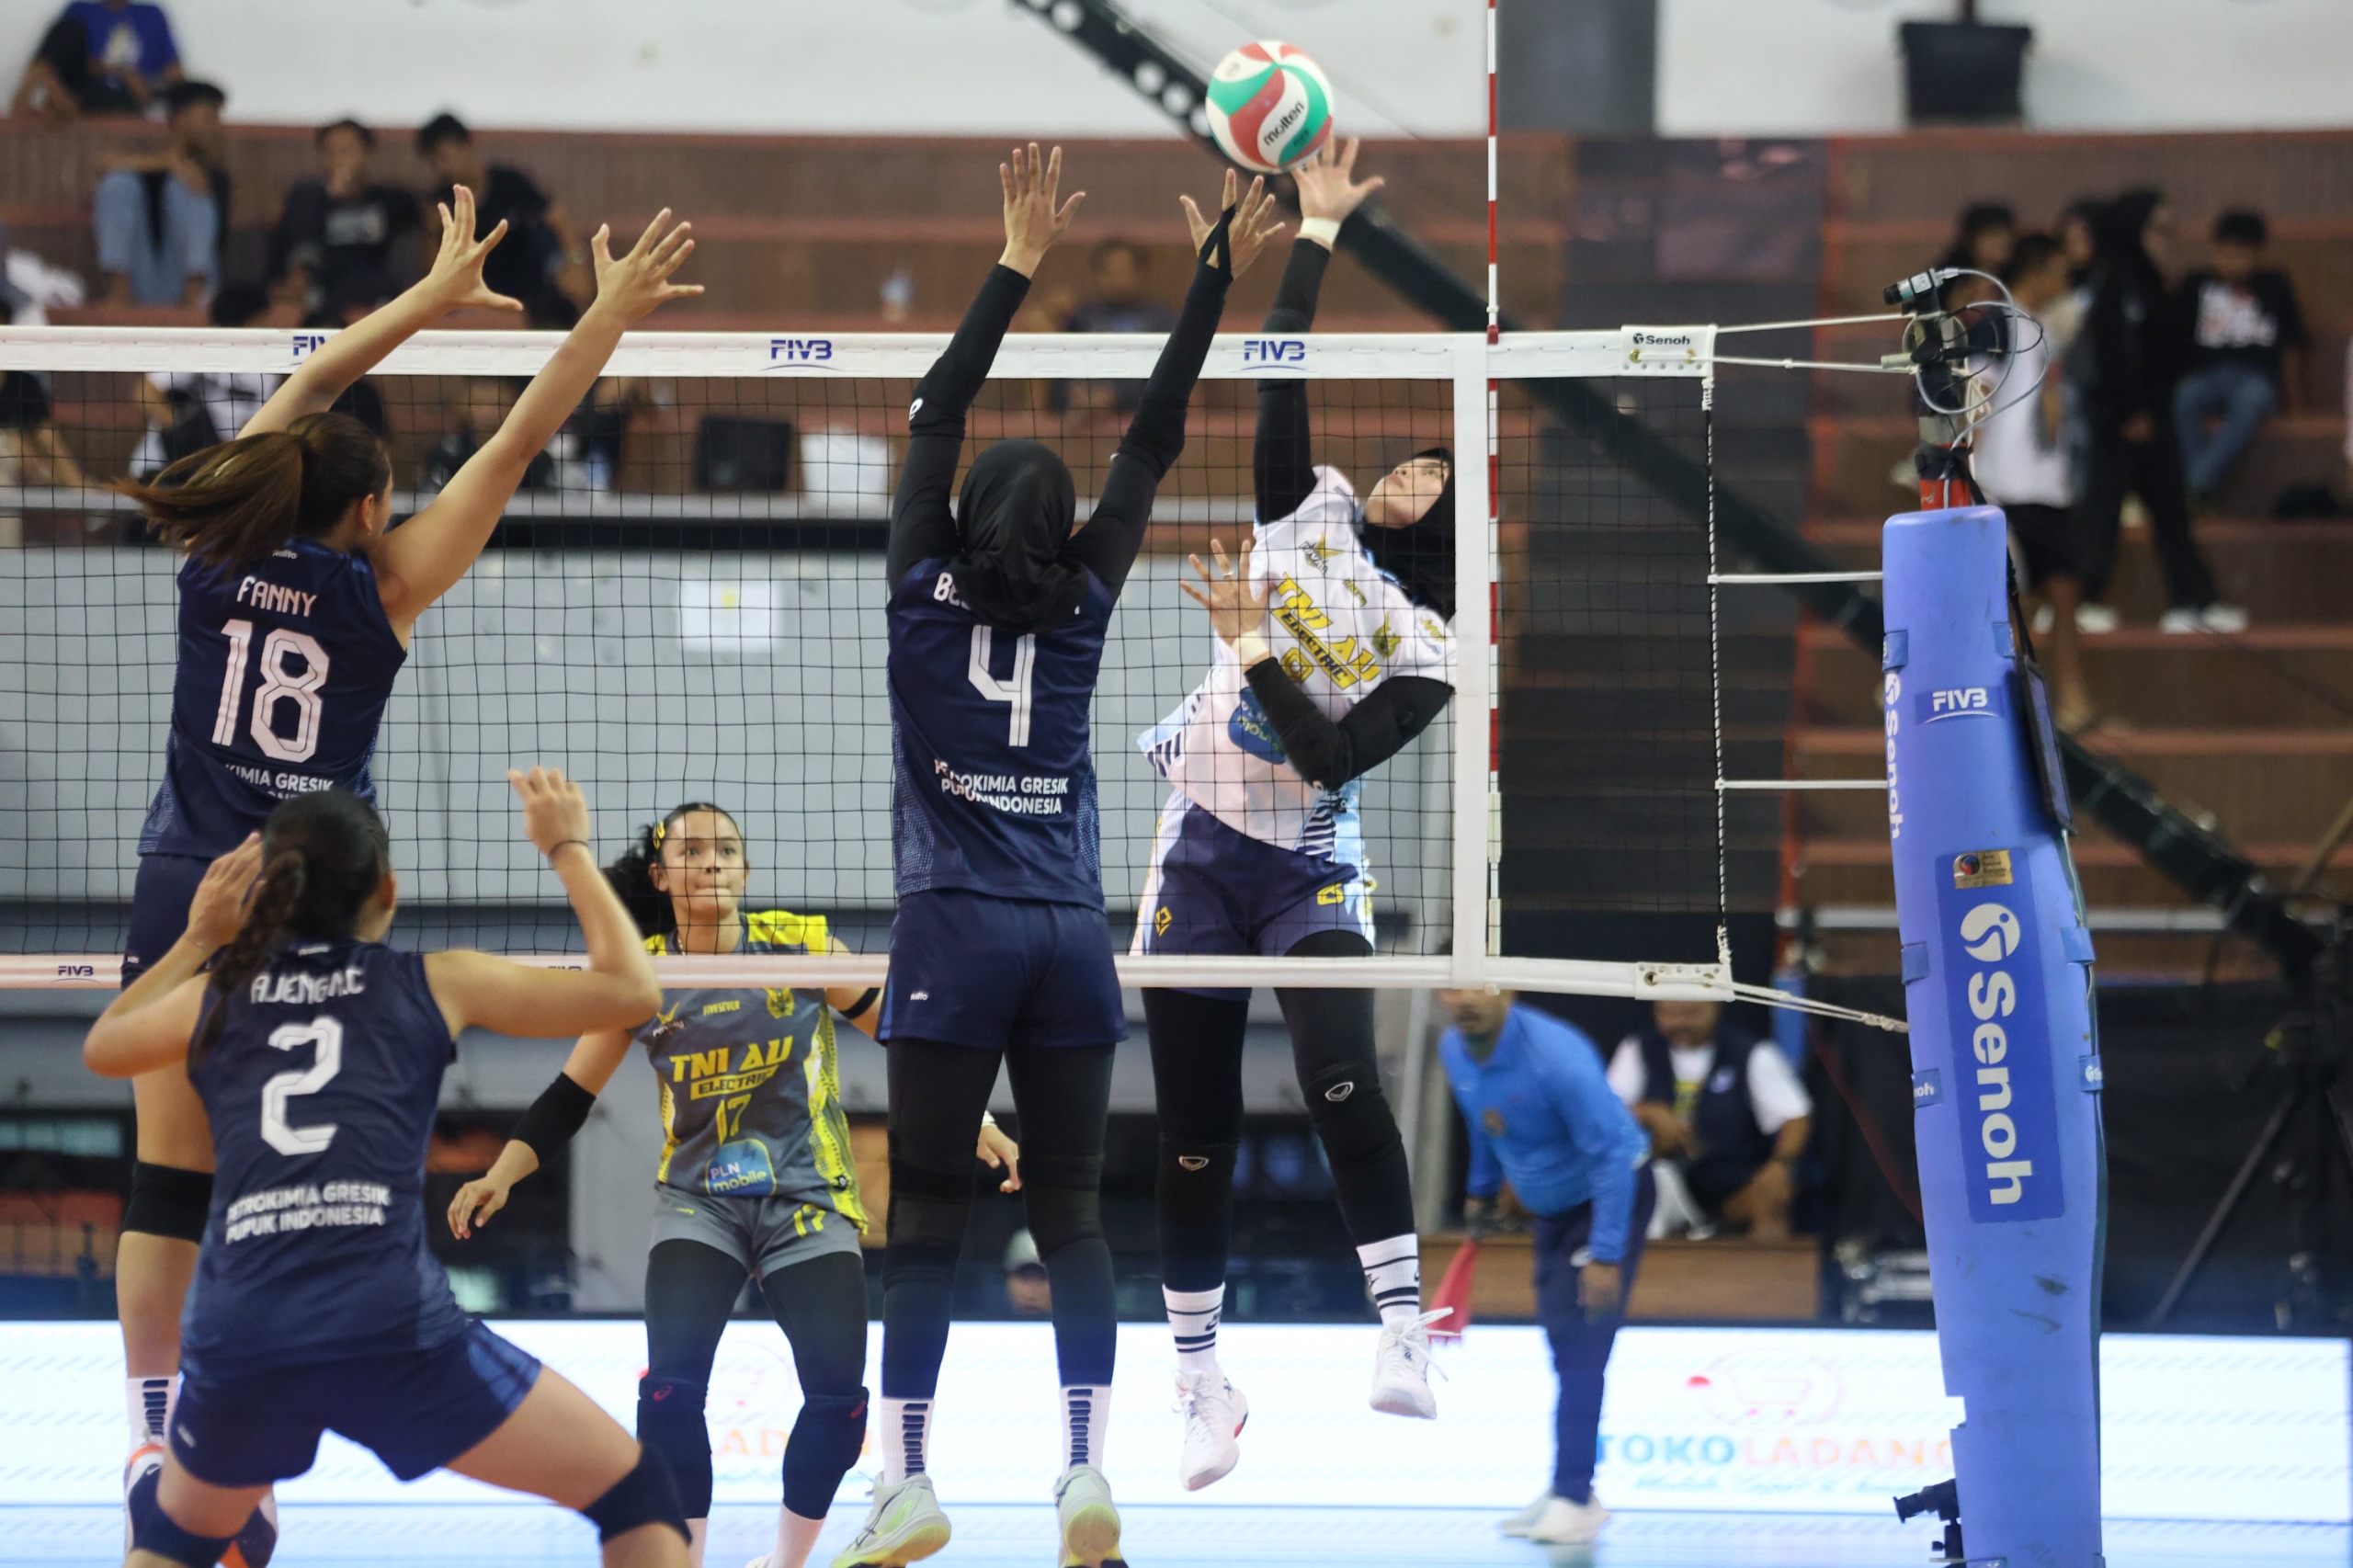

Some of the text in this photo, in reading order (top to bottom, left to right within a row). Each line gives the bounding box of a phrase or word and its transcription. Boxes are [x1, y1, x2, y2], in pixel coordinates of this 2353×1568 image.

[1263, 100, 1304, 147] molten
[293, 336, 325, 356] FI
[770, 339, 832, 360] FIVB
[1244, 341, 1305, 361] FIVB
[1645, 335, 1690, 345] Senoh
[236, 575, 317, 618] FANNY
[1281, 612, 1349, 682] ELECTRIC
[1329, 635, 1381, 682] AU
[211, 619, 330, 763] 18
[968, 624, 1036, 747] 4
[1932, 687, 1987, 711] FIVB
[275, 772, 334, 795] GRESIK
[1020, 777, 1069, 795] GRESIK
[1885, 709, 1904, 839] Senoh
[58, 966, 94, 976] FIVB
[669, 1036, 793, 1083] TNI AU
[260, 1016, 343, 1156] 2
[1968, 971, 2032, 1205] Senoh
[716, 1093, 752, 1147] 17
[710, 1162, 741, 1180] PLN
[713, 1170, 767, 1193] mobile
[323, 1182, 390, 1207] GRESIK
[279, 1206, 385, 1233] INDONESIA
